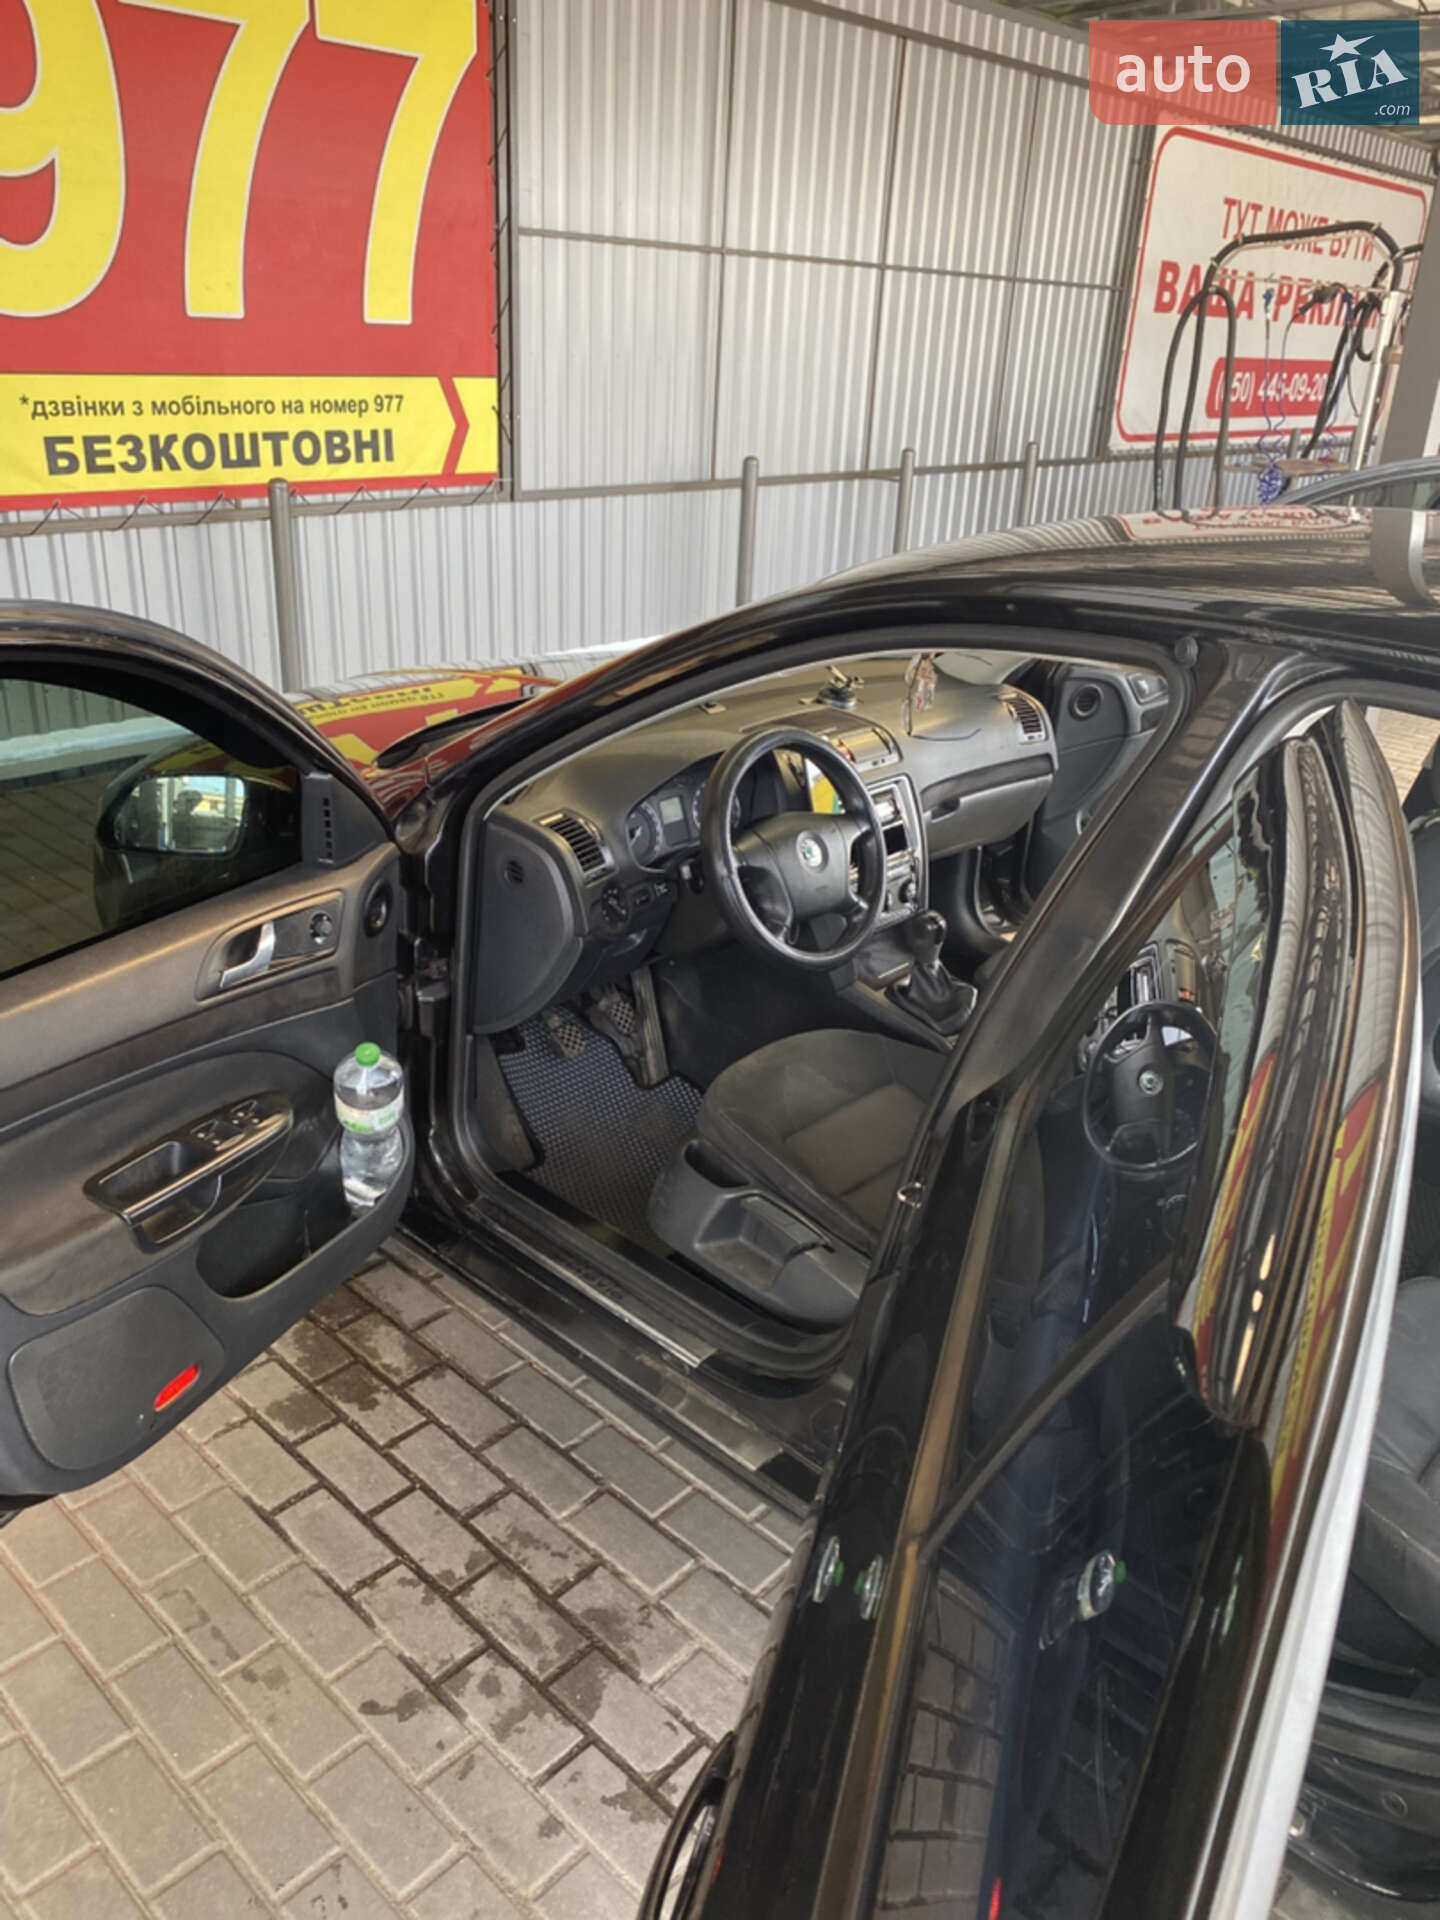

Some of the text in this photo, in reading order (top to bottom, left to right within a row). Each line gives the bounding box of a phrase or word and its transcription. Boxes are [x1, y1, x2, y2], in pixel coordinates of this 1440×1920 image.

[1222, 197, 1263, 241] ТУТ
[1153, 259, 1255, 320] ВАША
[132, 401, 144, 416] з
[151, 395, 276, 416] мобільного
[282, 400, 304, 414] на
[310, 398, 369, 417] номер
[373, 394, 404, 413] 977
[1215, 370, 1256, 411] (50)
[43, 428, 394, 476] БЕЗКОШТОВНІ
